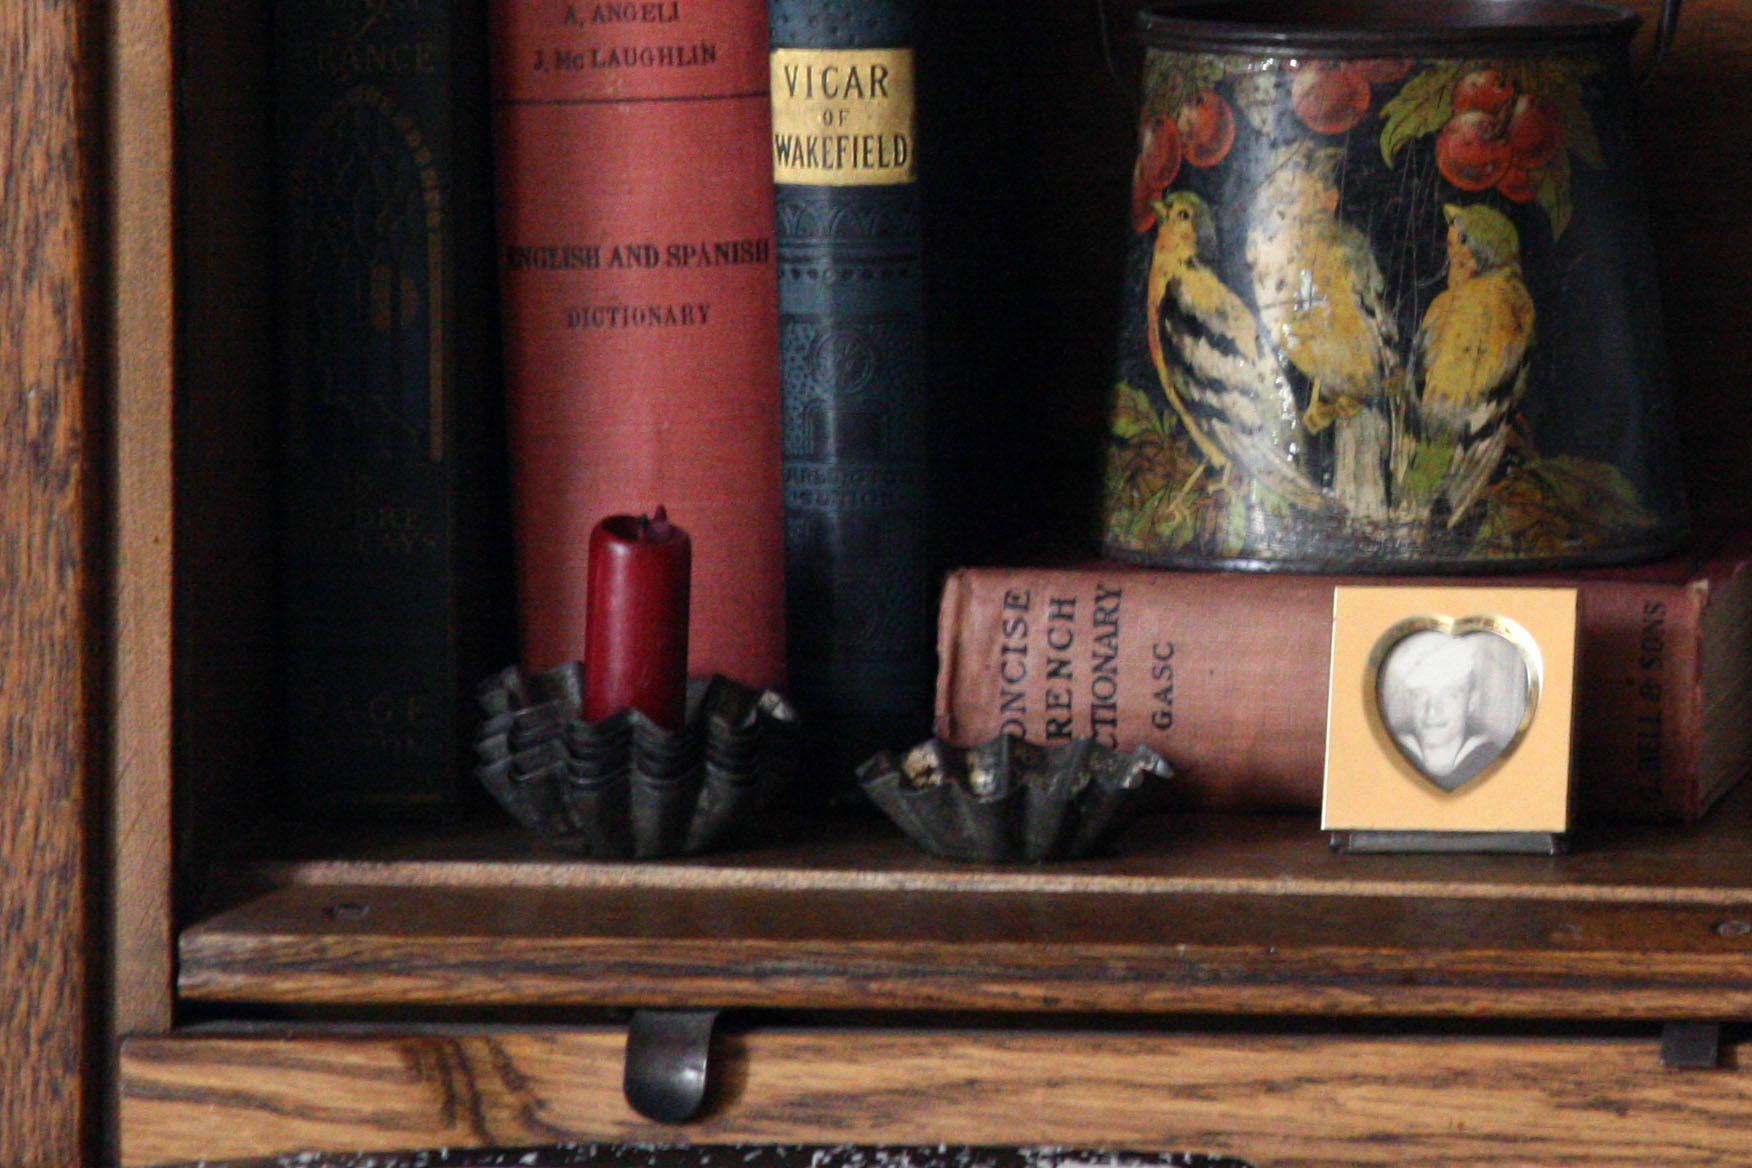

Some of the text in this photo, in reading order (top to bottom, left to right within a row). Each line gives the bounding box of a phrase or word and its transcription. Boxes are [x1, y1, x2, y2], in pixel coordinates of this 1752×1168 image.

[591, 0, 680, 24] ANGELI
[591, 41, 718, 69] LAUGHLIN
[784, 64, 889, 100] VICAR
[822, 109, 850, 127] OF
[774, 133, 908, 170] WAKEFIELD
[506, 238, 770, 271] ENGLISH AND SPANISH
[566, 303, 712, 330] DICTIONARY
[1639, 600, 1667, 670] SONS
[999, 588, 1031, 741] ONCISE
[1045, 594, 1077, 742] RENCH
[1151, 640, 1175, 731] GASC
